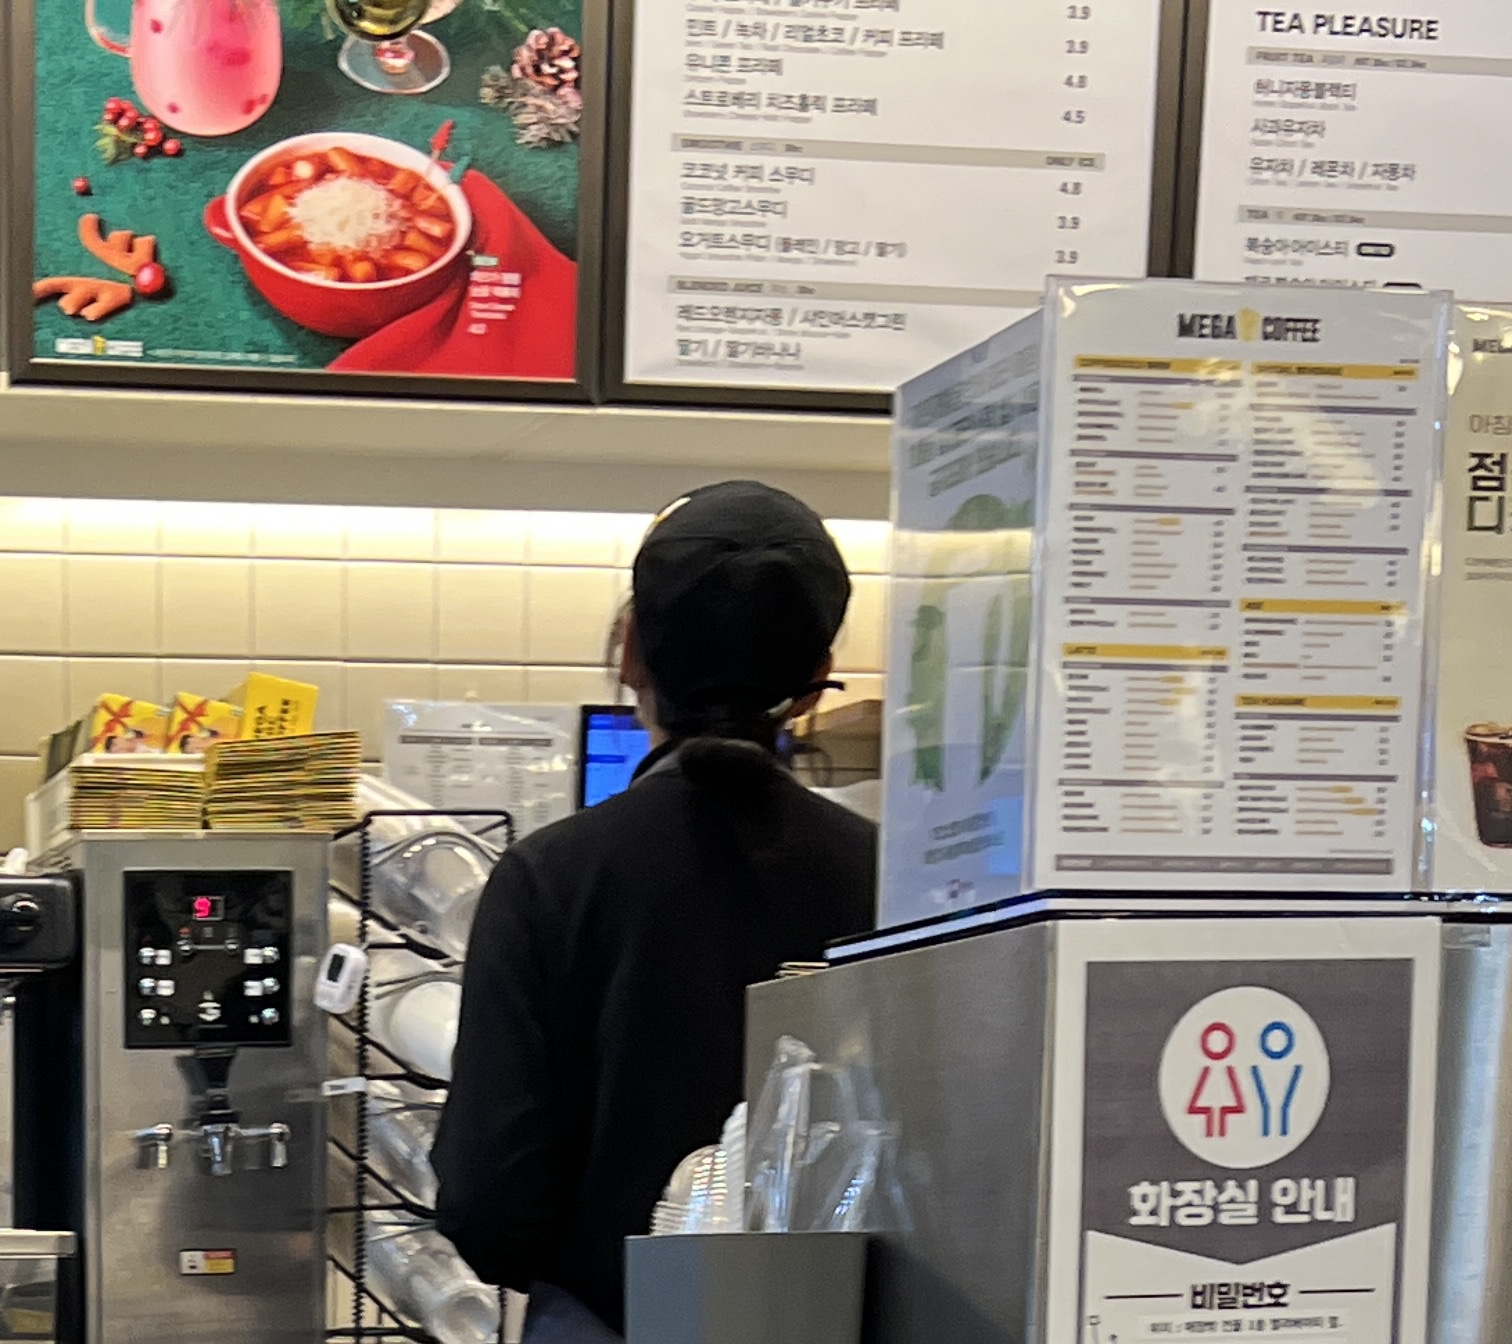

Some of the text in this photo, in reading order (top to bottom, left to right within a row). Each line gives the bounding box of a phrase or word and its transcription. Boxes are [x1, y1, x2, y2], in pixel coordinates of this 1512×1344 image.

[1256, 10, 1439, 40] TEA PLEASURE
[1177, 312, 1322, 344] MEGA COFFEE
[1128, 1176, 1356, 1227] 화장실 안내
[1190, 1279, 1291, 1310] 비밀번호
